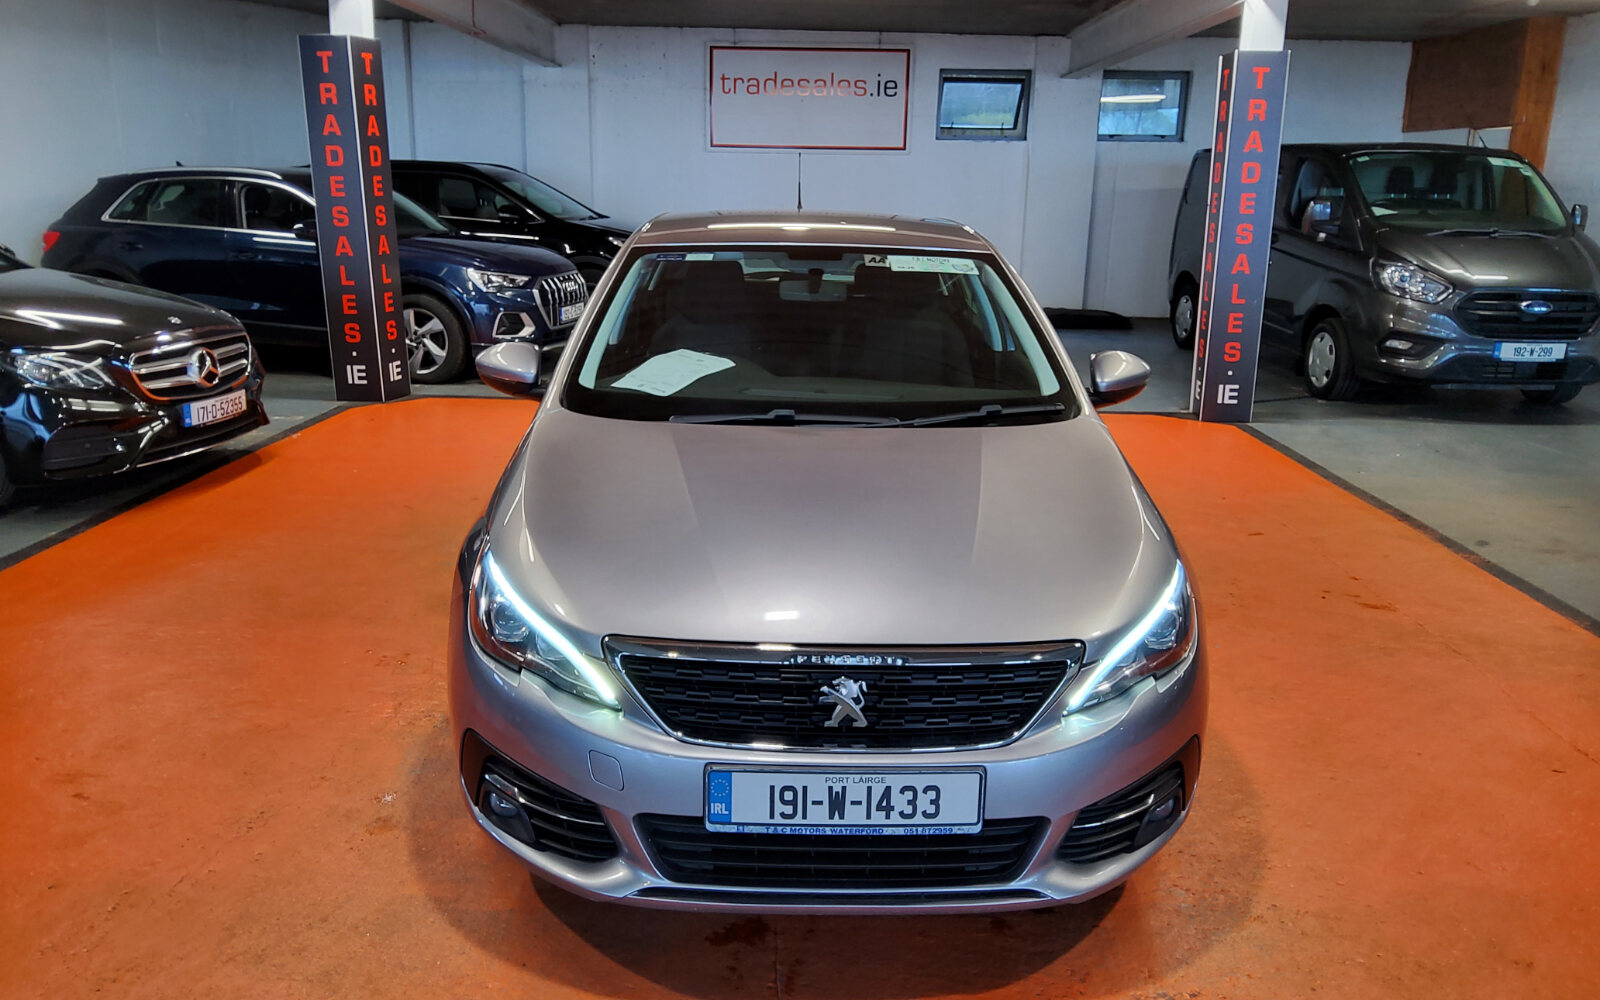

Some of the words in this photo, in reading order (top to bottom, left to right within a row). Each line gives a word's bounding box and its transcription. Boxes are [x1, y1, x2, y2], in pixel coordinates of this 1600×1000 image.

[720, 71, 898, 97] tradesales.ie
[316, 50, 368, 385] TRADESALES.IE
[360, 52, 402, 382] TRADESALES.IE
[1195, 68, 1230, 400] TRADESALES.E
[1216, 67, 1270, 404] TRADESALES.IE
[1513, 347, 1553, 357] 192-W-299
[825, 776, 849, 784] PORT
[852, 775, 887, 784] LÁIRGE
[710, 802, 729, 815] IRL
[769, 784, 941, 820] 191-W-1433
[765, 826, 771, 834] T
[772, 826, 779, 834] &
[790, 827, 827, 835] MOTORS
[830, 827, 884, 835] WATERFORD
